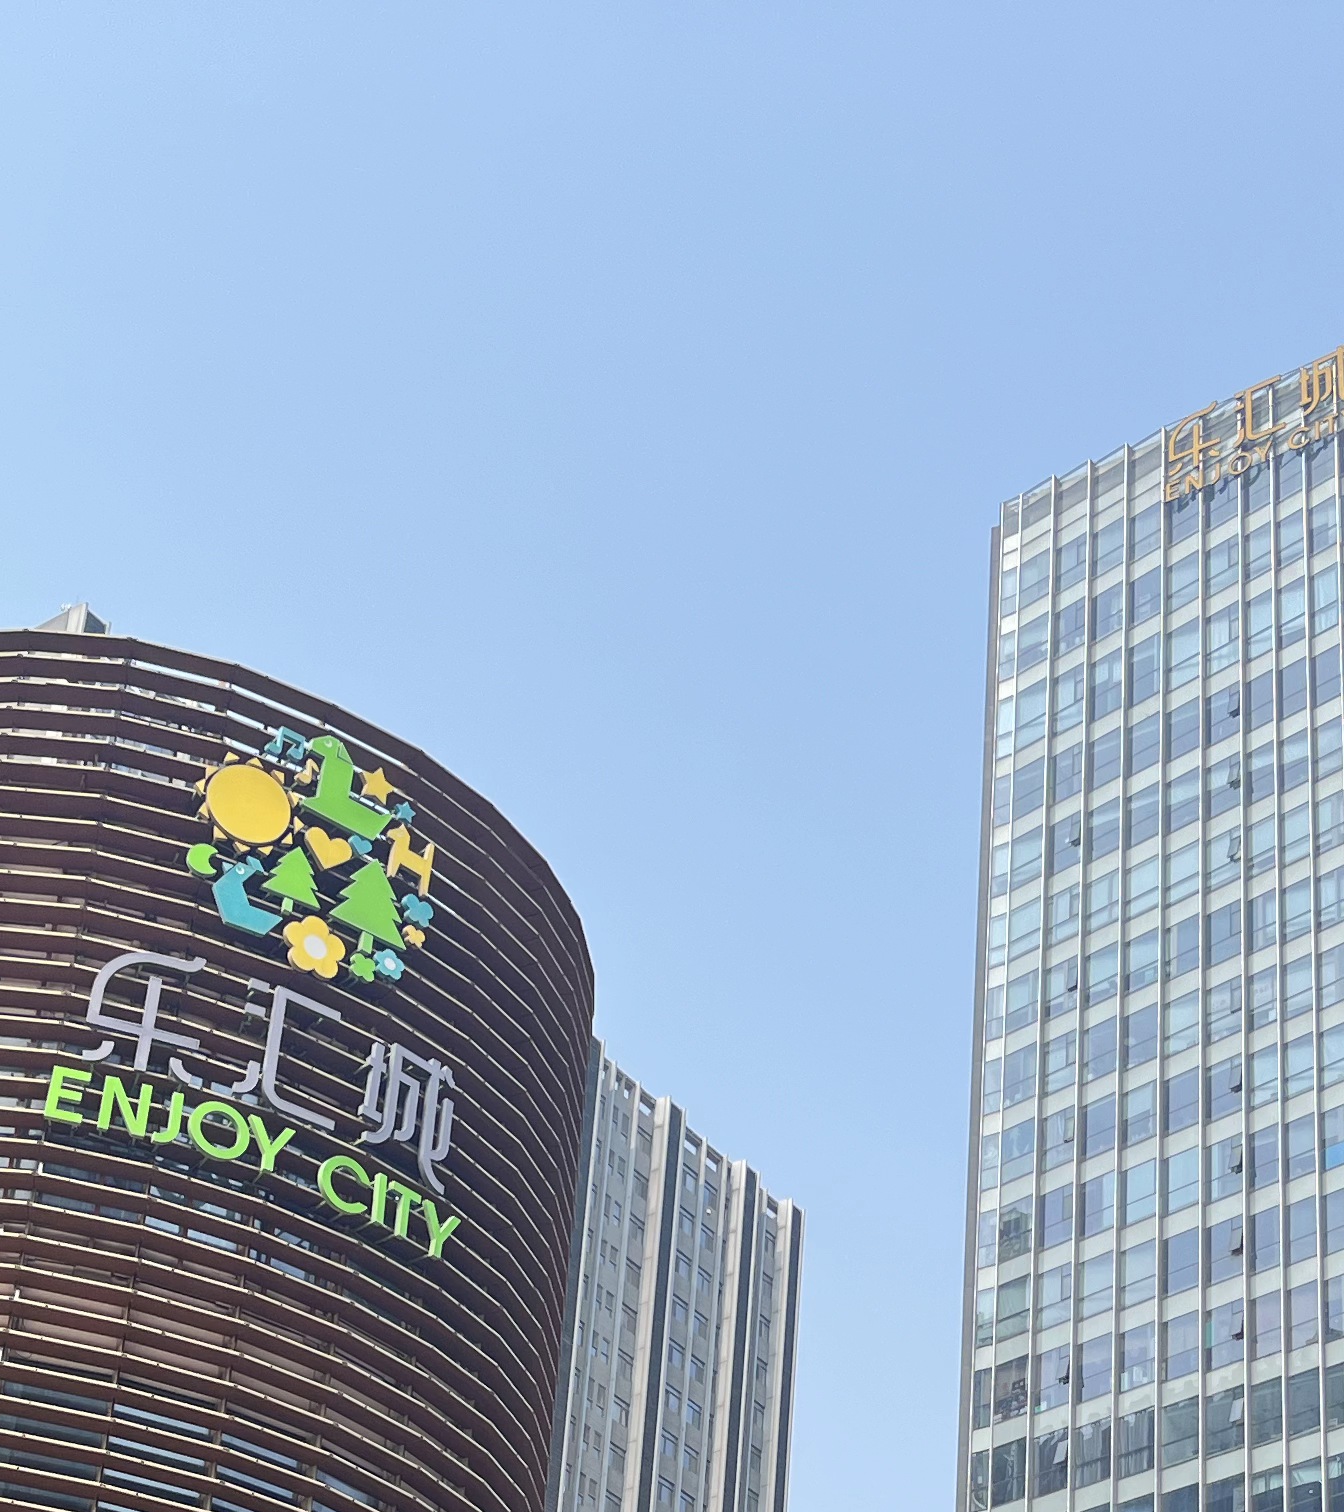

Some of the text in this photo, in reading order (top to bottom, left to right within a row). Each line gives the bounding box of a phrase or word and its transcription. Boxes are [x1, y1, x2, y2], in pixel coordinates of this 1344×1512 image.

[1164, 441, 1273, 502] ENJOY
[43, 1065, 462, 1259] ENJOY CITY
[82, 951, 455, 1194] 乐汇城
